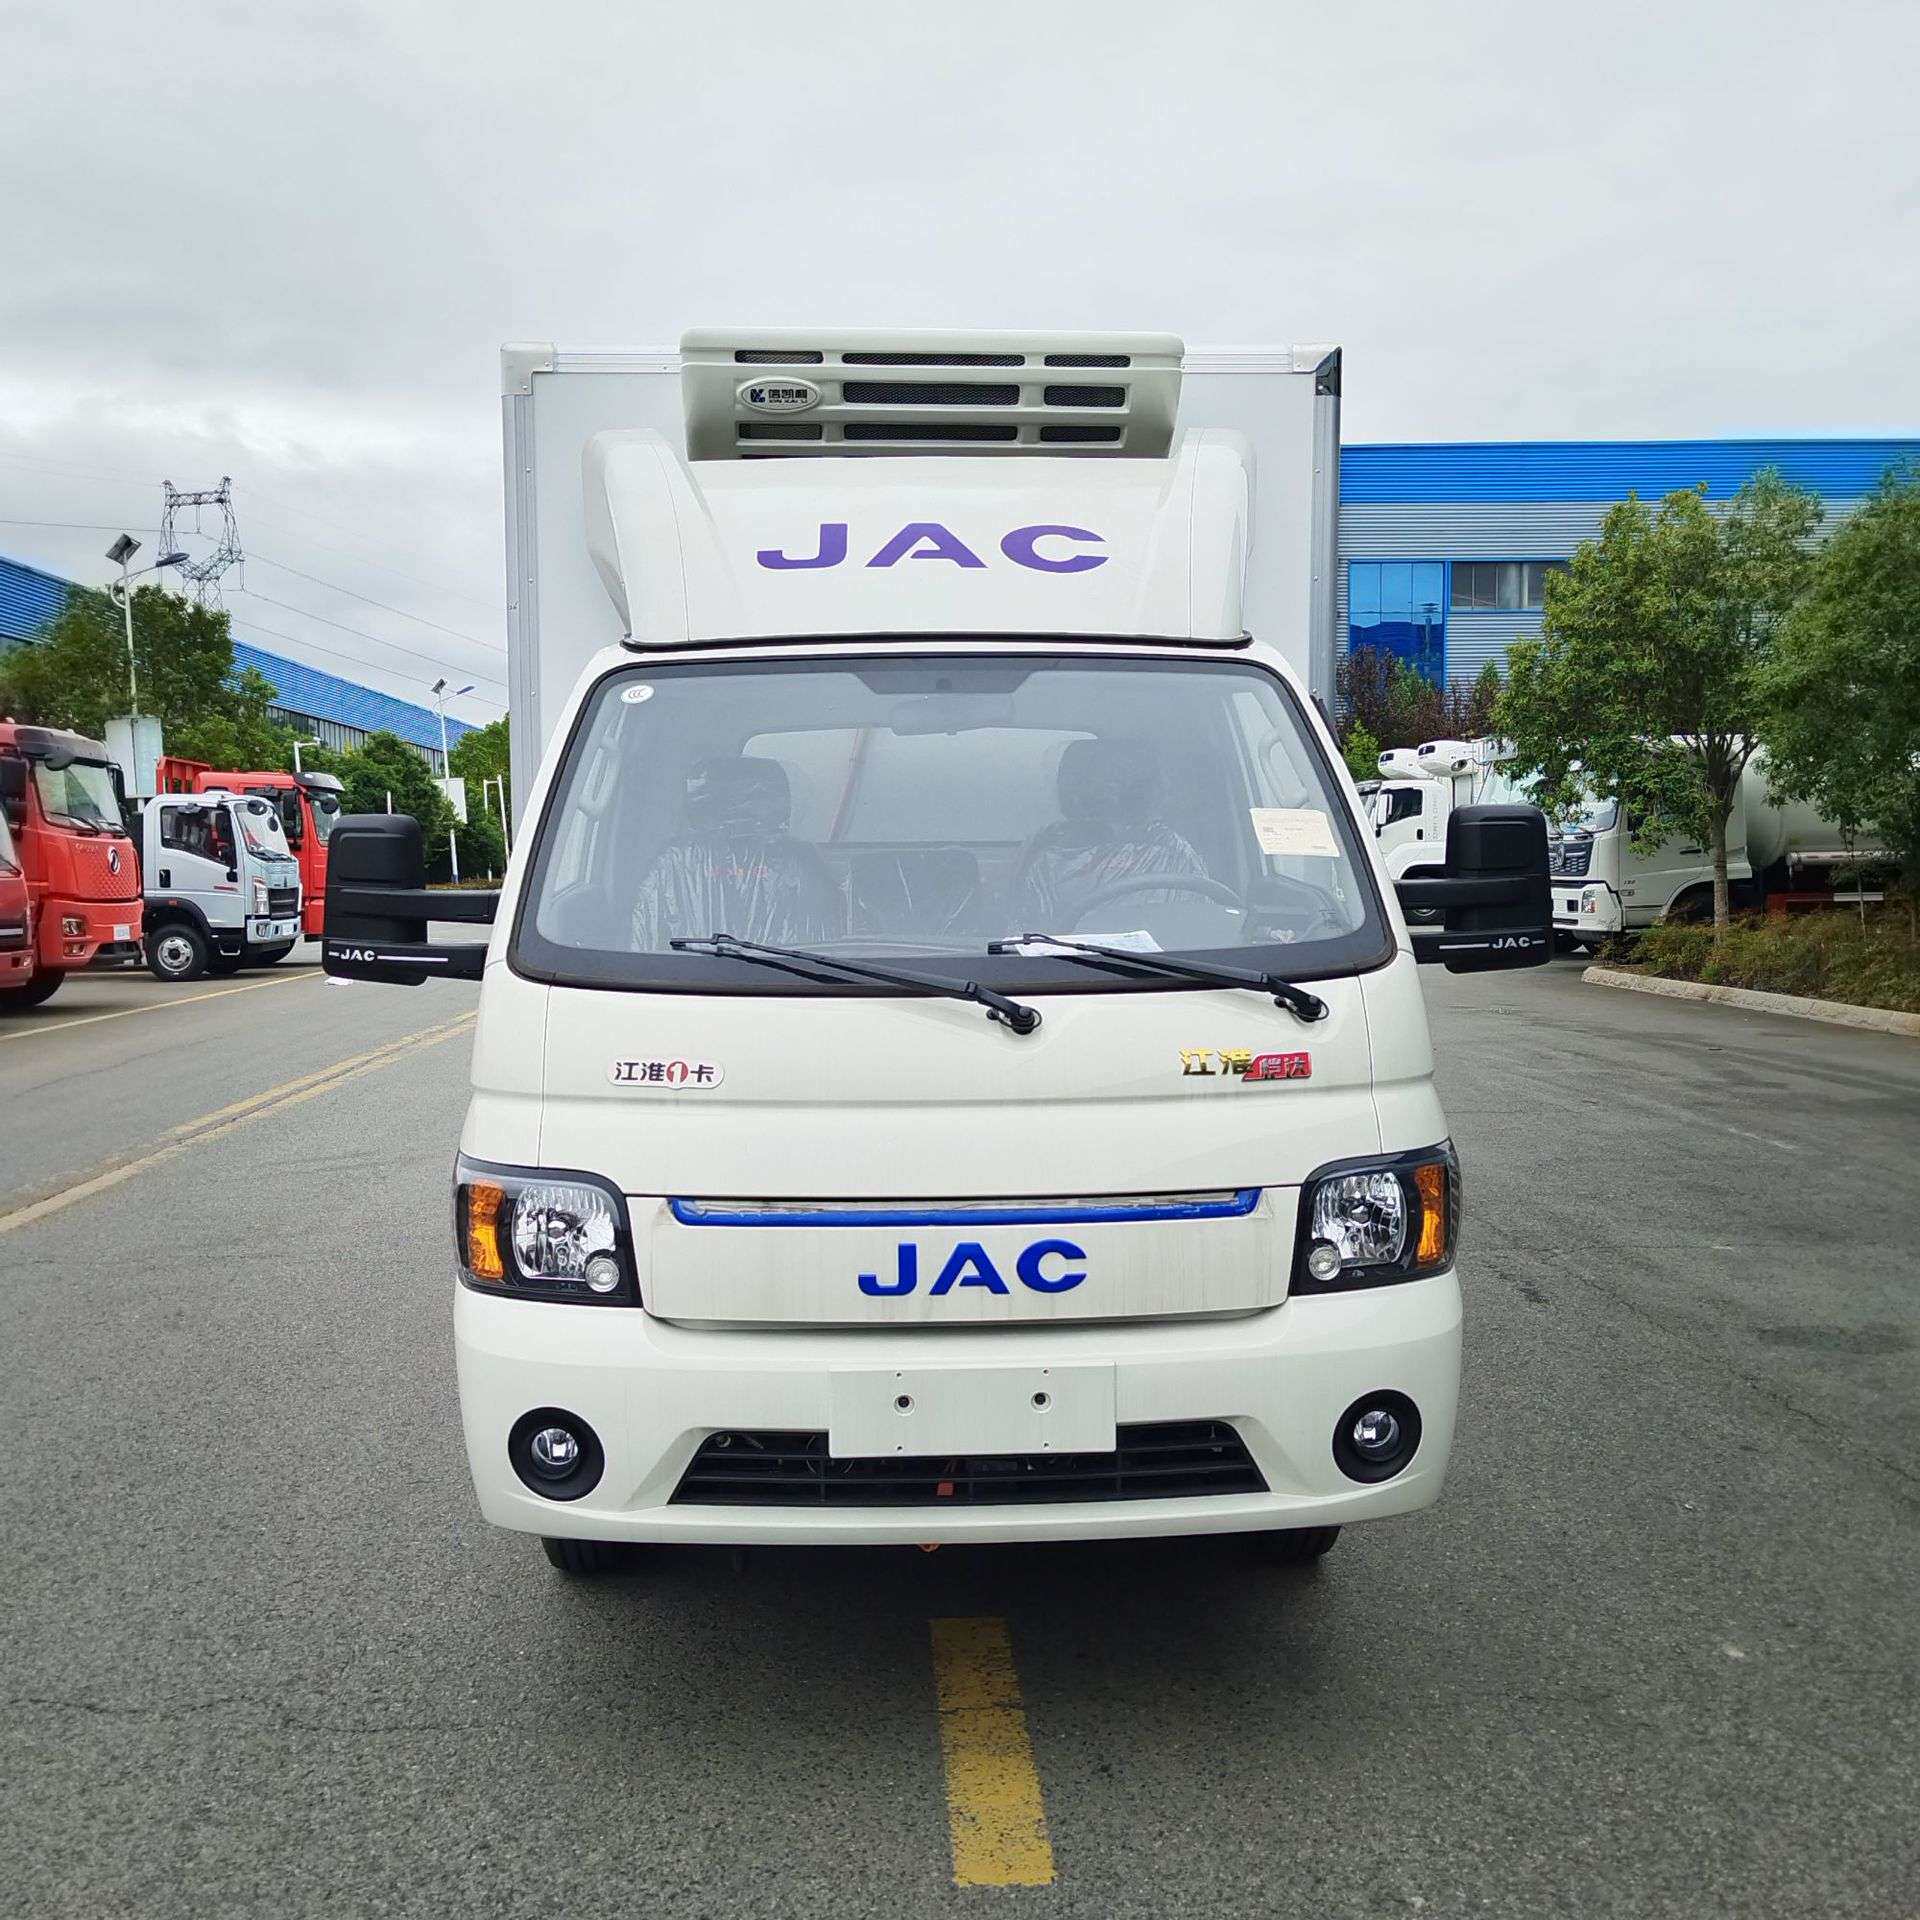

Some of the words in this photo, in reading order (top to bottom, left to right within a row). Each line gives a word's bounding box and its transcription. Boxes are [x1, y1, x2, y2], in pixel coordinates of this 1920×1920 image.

[756, 522, 1111, 574] JAC
[340, 949, 375, 961] JAC
[1492, 937, 1530, 949] JAC
[857, 1238, 1088, 1296] JAC
